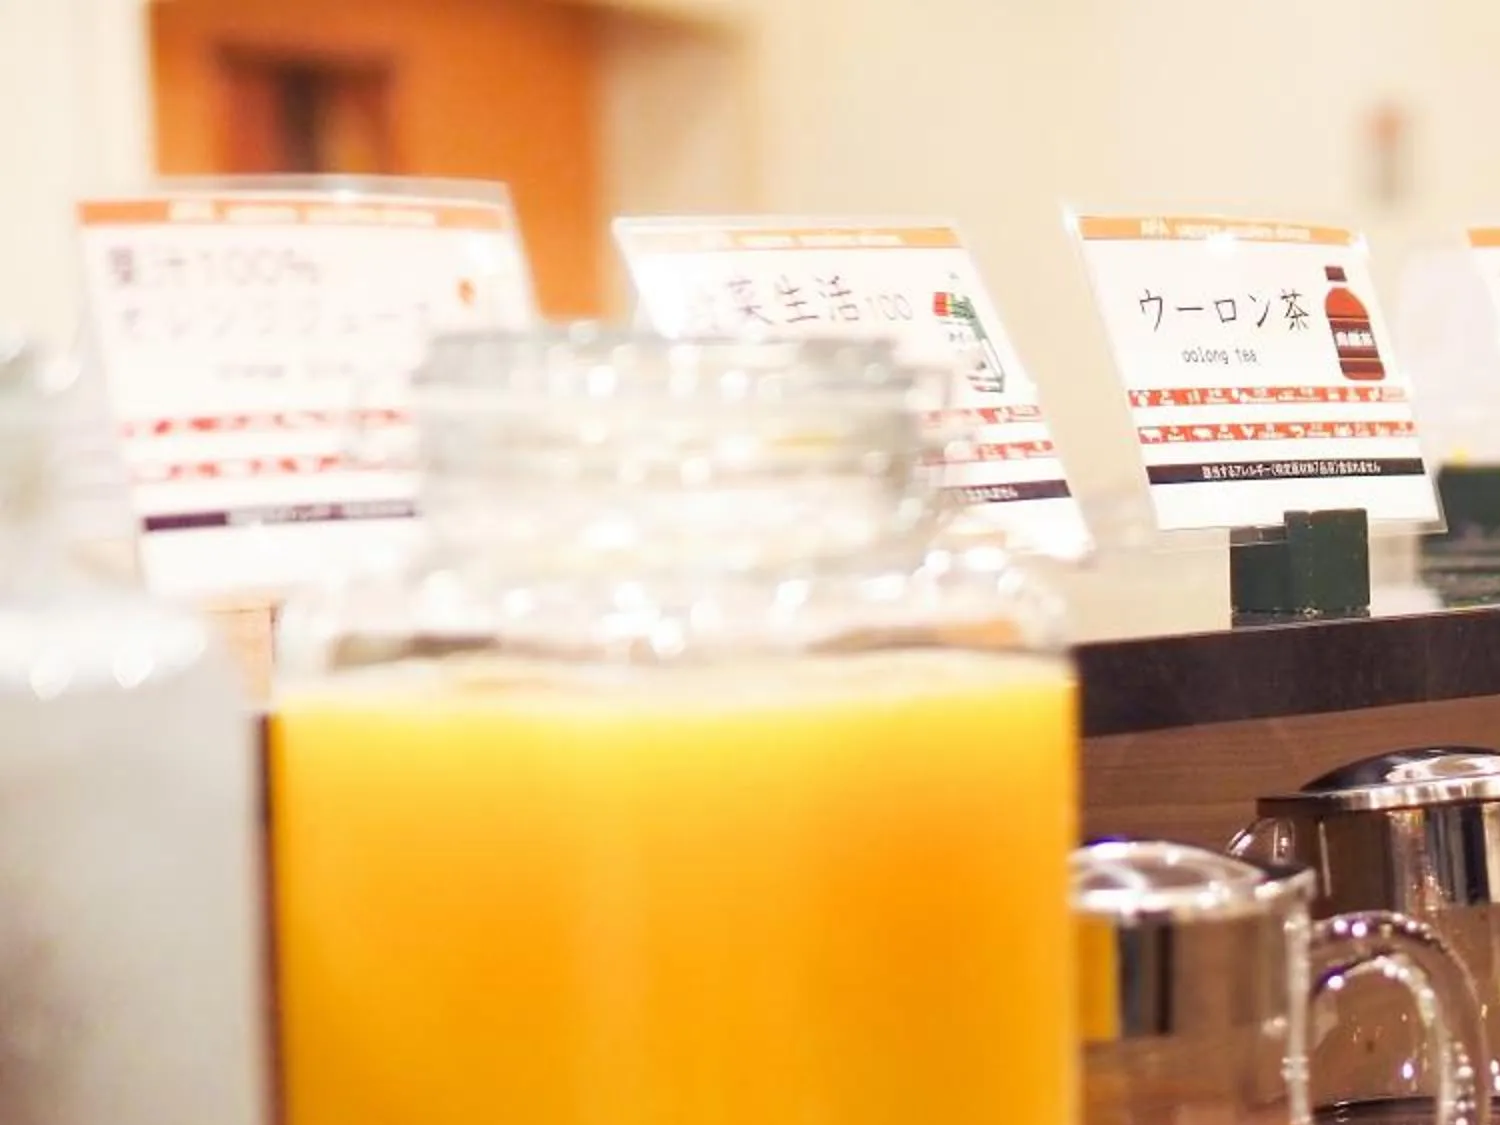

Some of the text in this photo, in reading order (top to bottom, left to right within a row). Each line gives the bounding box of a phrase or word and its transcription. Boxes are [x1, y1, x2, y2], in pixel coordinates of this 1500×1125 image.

[688, 273, 915, 328] 菜生活100
[1138, 288, 1310, 333] ウーロン茶
[1181, 346, 1258, 365] oolong tea
